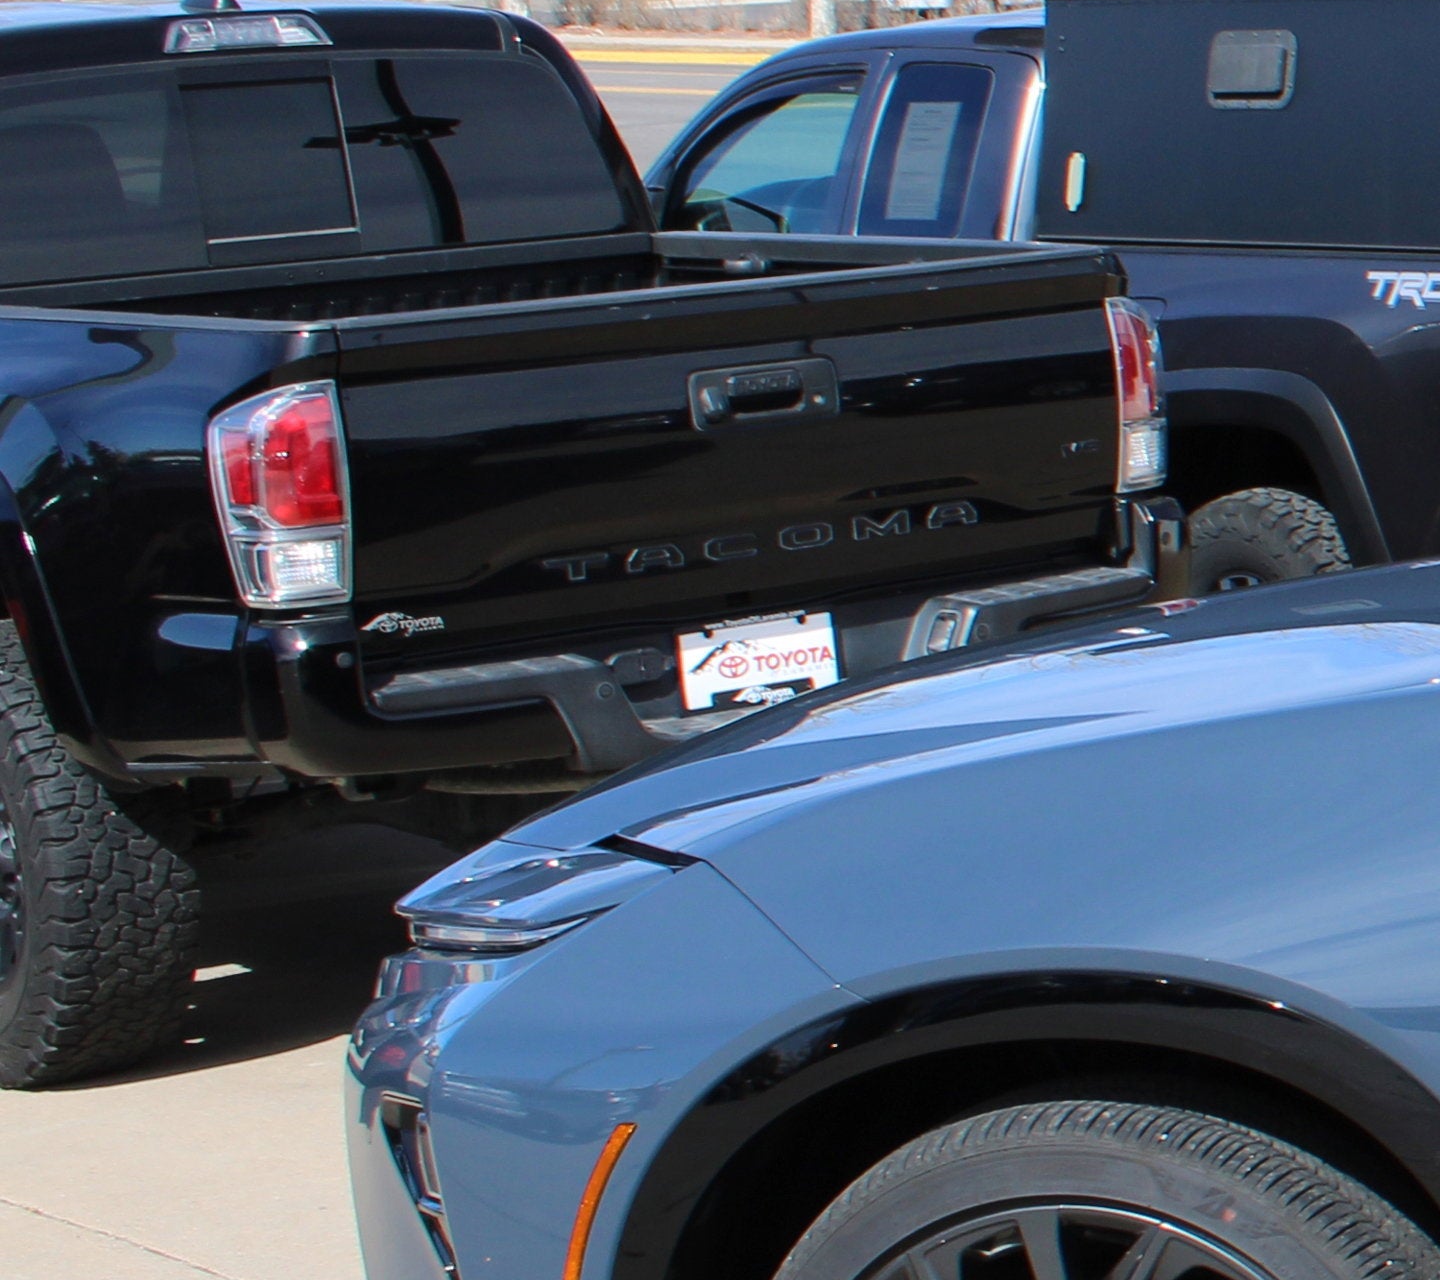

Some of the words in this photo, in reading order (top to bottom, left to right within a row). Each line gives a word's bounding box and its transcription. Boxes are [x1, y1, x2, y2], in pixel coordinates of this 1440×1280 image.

[542, 500, 979, 581] TACOMA
[399, 616, 444, 629] TOYOTA
[753, 645, 834, 672] TOYOTA
